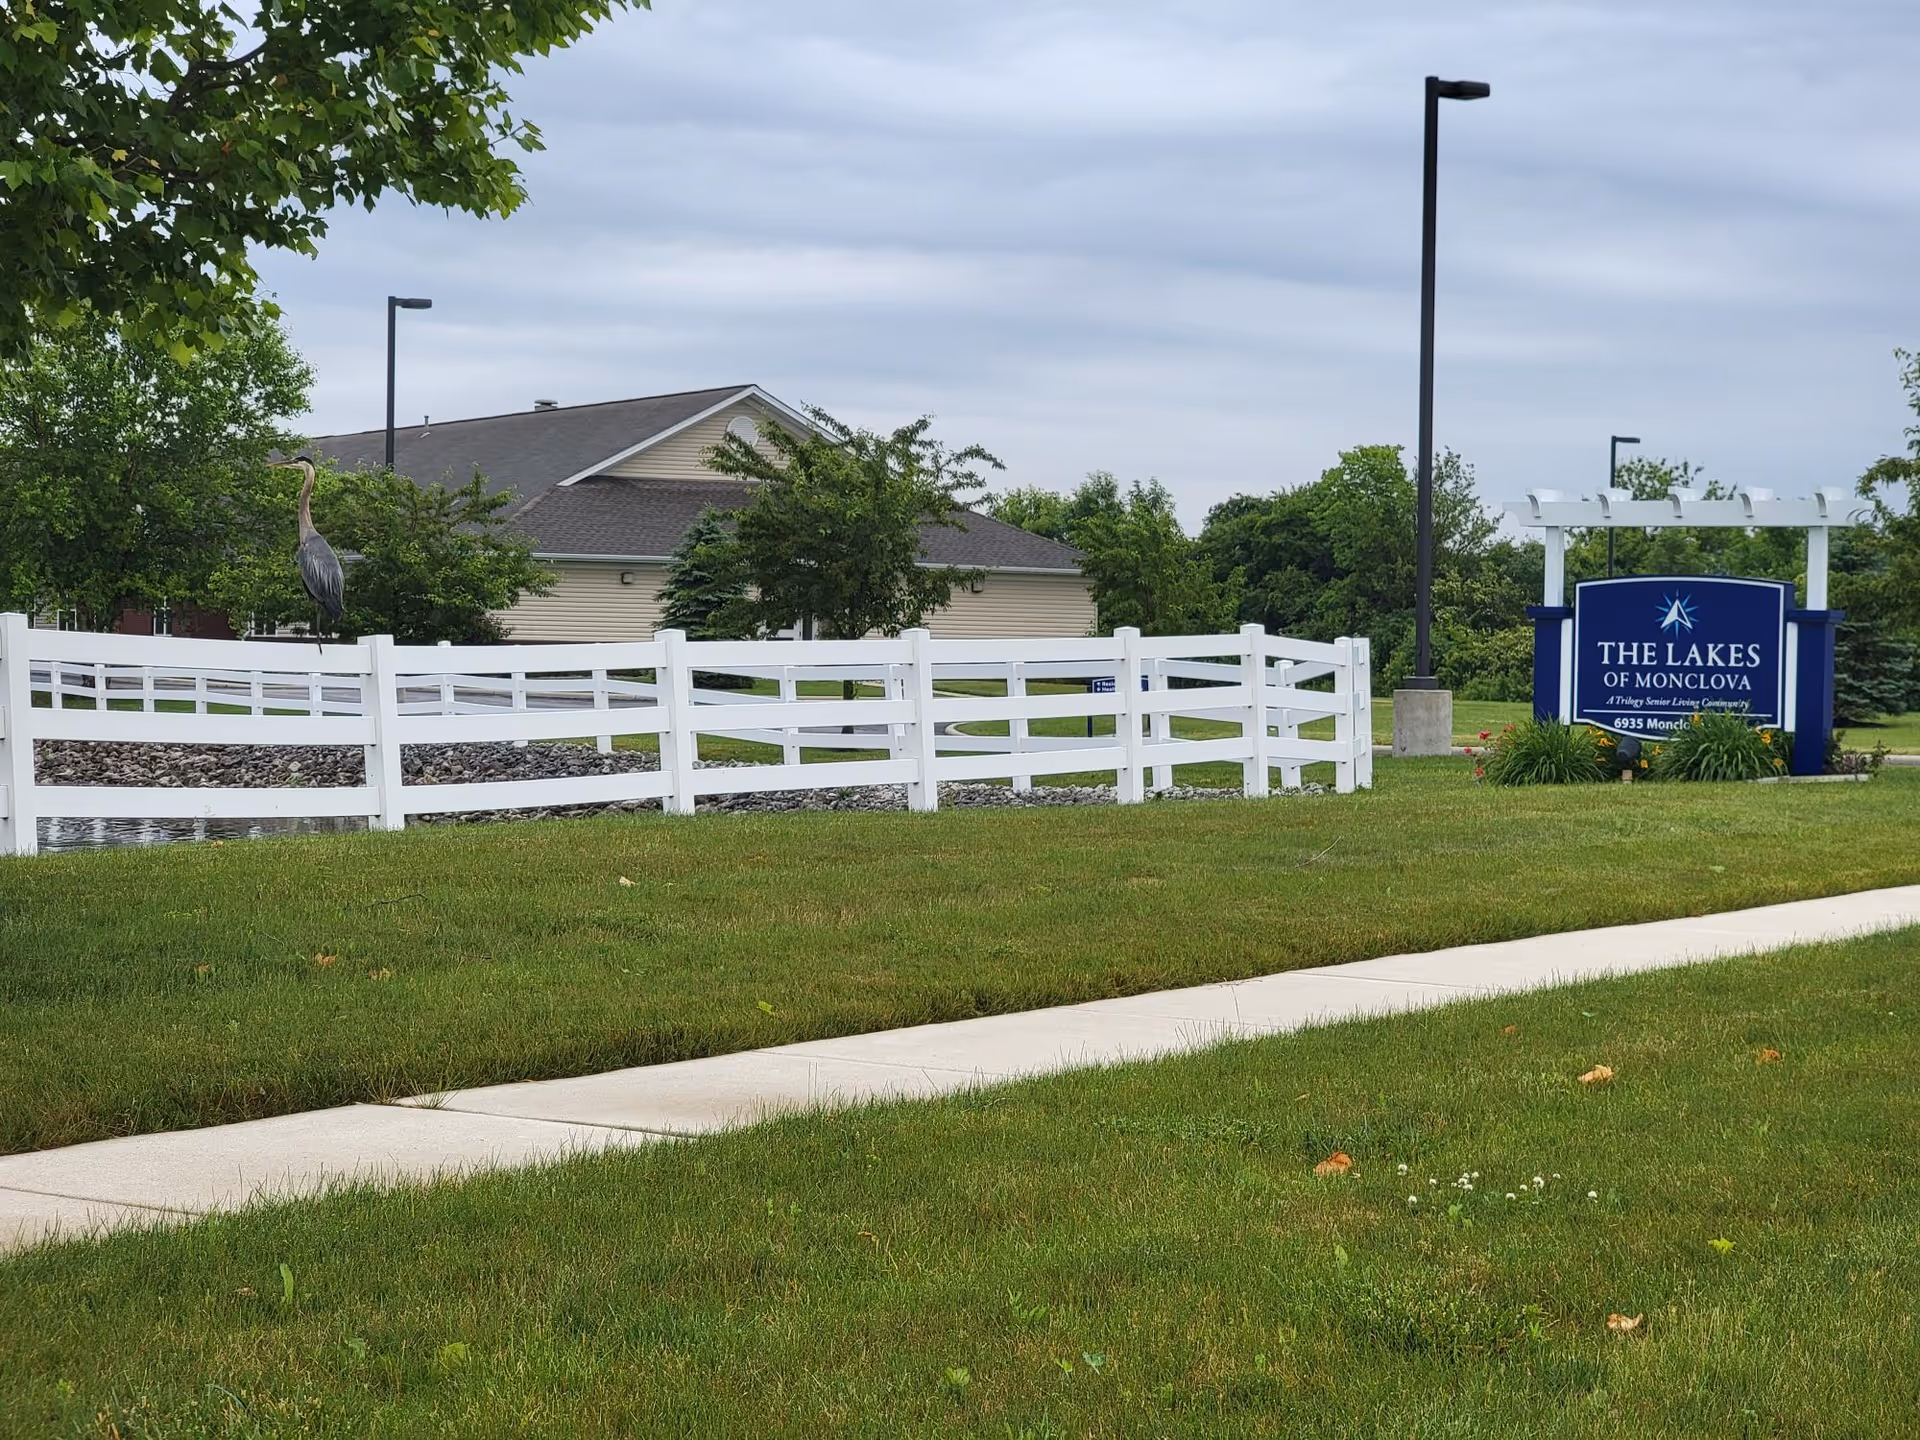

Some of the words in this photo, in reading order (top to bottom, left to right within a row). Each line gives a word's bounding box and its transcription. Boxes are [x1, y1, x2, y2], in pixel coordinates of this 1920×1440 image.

[1598, 642, 1657, 665] THE
[1666, 643, 1760, 668] LAKES
[1604, 672, 1630, 688] OF
[1635, 672, 1752, 690] MONCLOVA
[1606, 696, 1614, 704] A
[1615, 696, 1644, 708] Trilogy
[1646, 697, 1671, 706] Senior
[1672, 698, 1700, 709] Living
[1614, 718, 1644, 729] 6935
